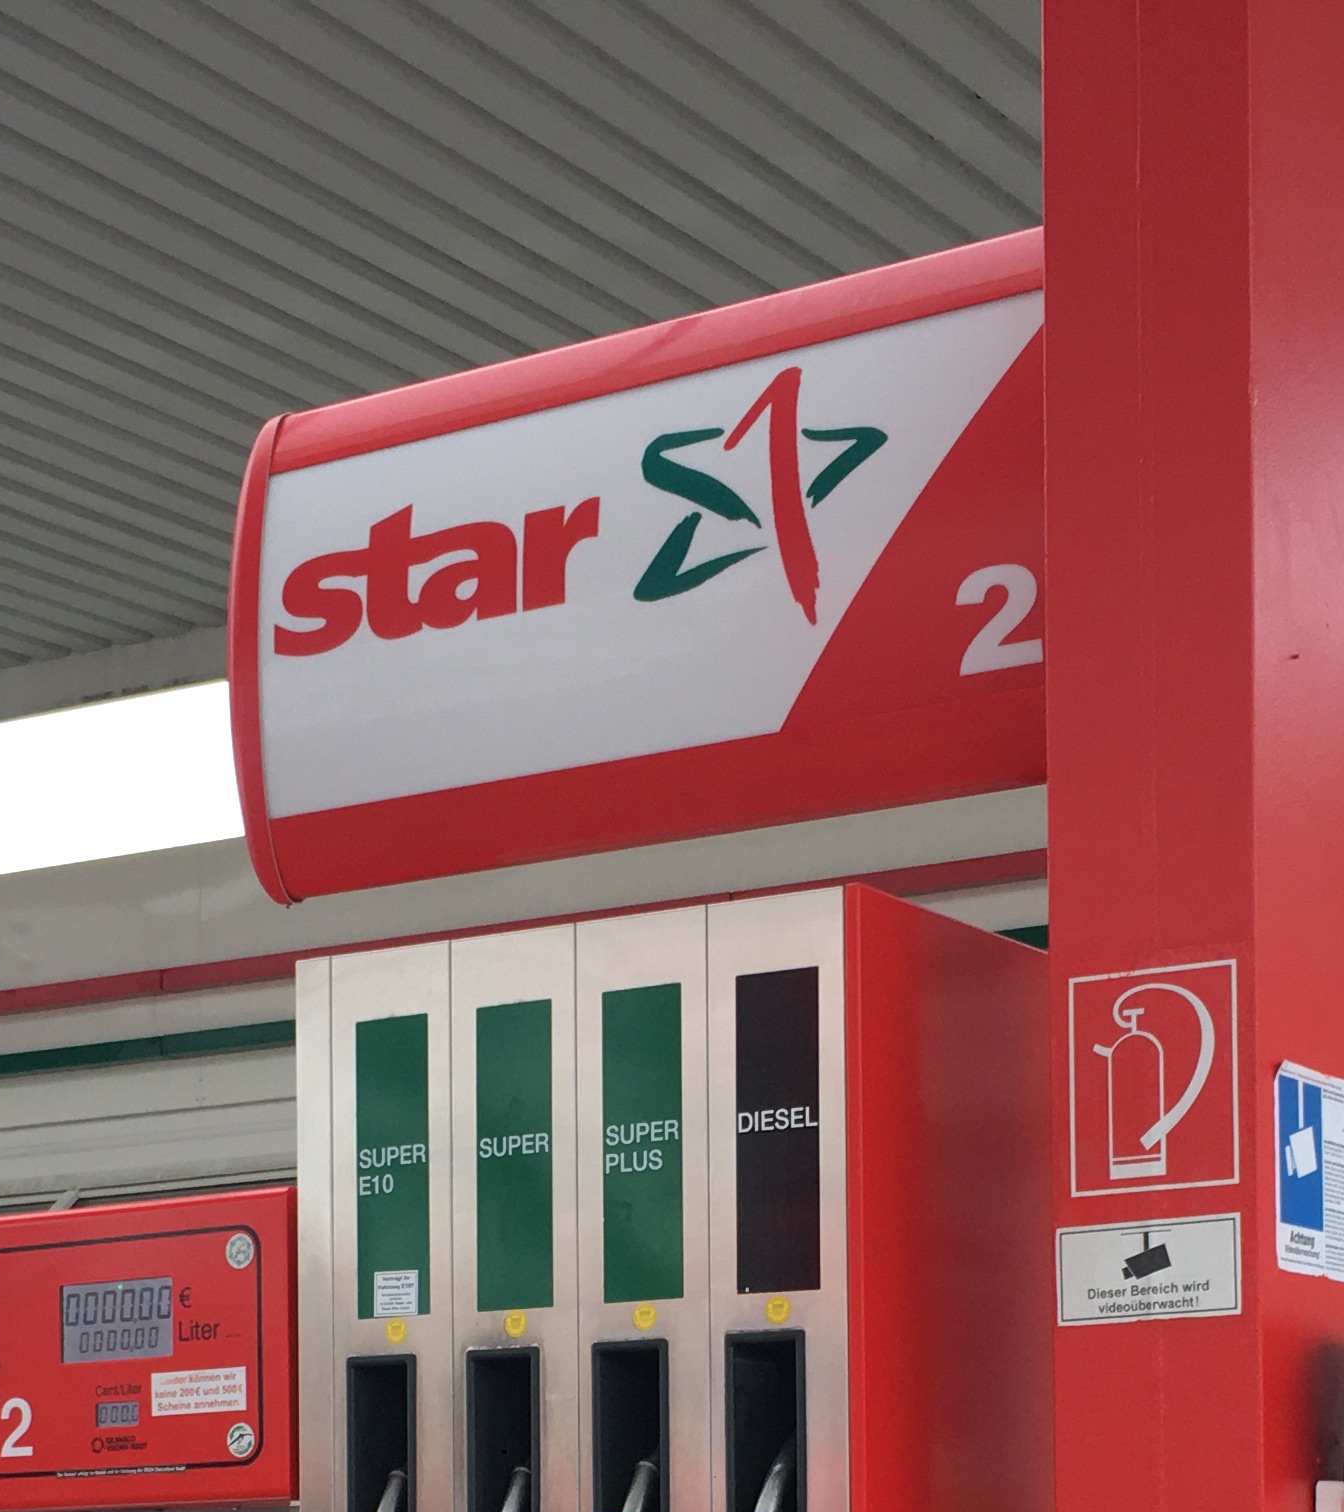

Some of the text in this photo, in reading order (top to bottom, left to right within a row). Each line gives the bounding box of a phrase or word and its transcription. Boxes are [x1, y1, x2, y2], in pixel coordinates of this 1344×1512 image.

[274, 496, 600, 656] star
[954, 563, 1044, 677] 2
[606, 1119, 679, 1146] SUPER
[737, 1107, 819, 1134] DIESEL
[359, 1143, 427, 1169] SUPER
[479, 1132, 549, 1159] SUPER
[606, 1149, 664, 1175] PLUS
[359, 1174, 394, 1196] E10
[179, 1286, 192, 1308] €
[1087, 1279, 1210, 1300] Dieser Bereich wird
[178, 1320, 220, 1342] Liter
[188, 1373, 221, 1384] können
[223, 1372, 237, 1381] wir
[203, 1386, 220, 1396] und
[157, 1402, 191, 1412] Scheine
[0, 1397, 33, 1458] 2
